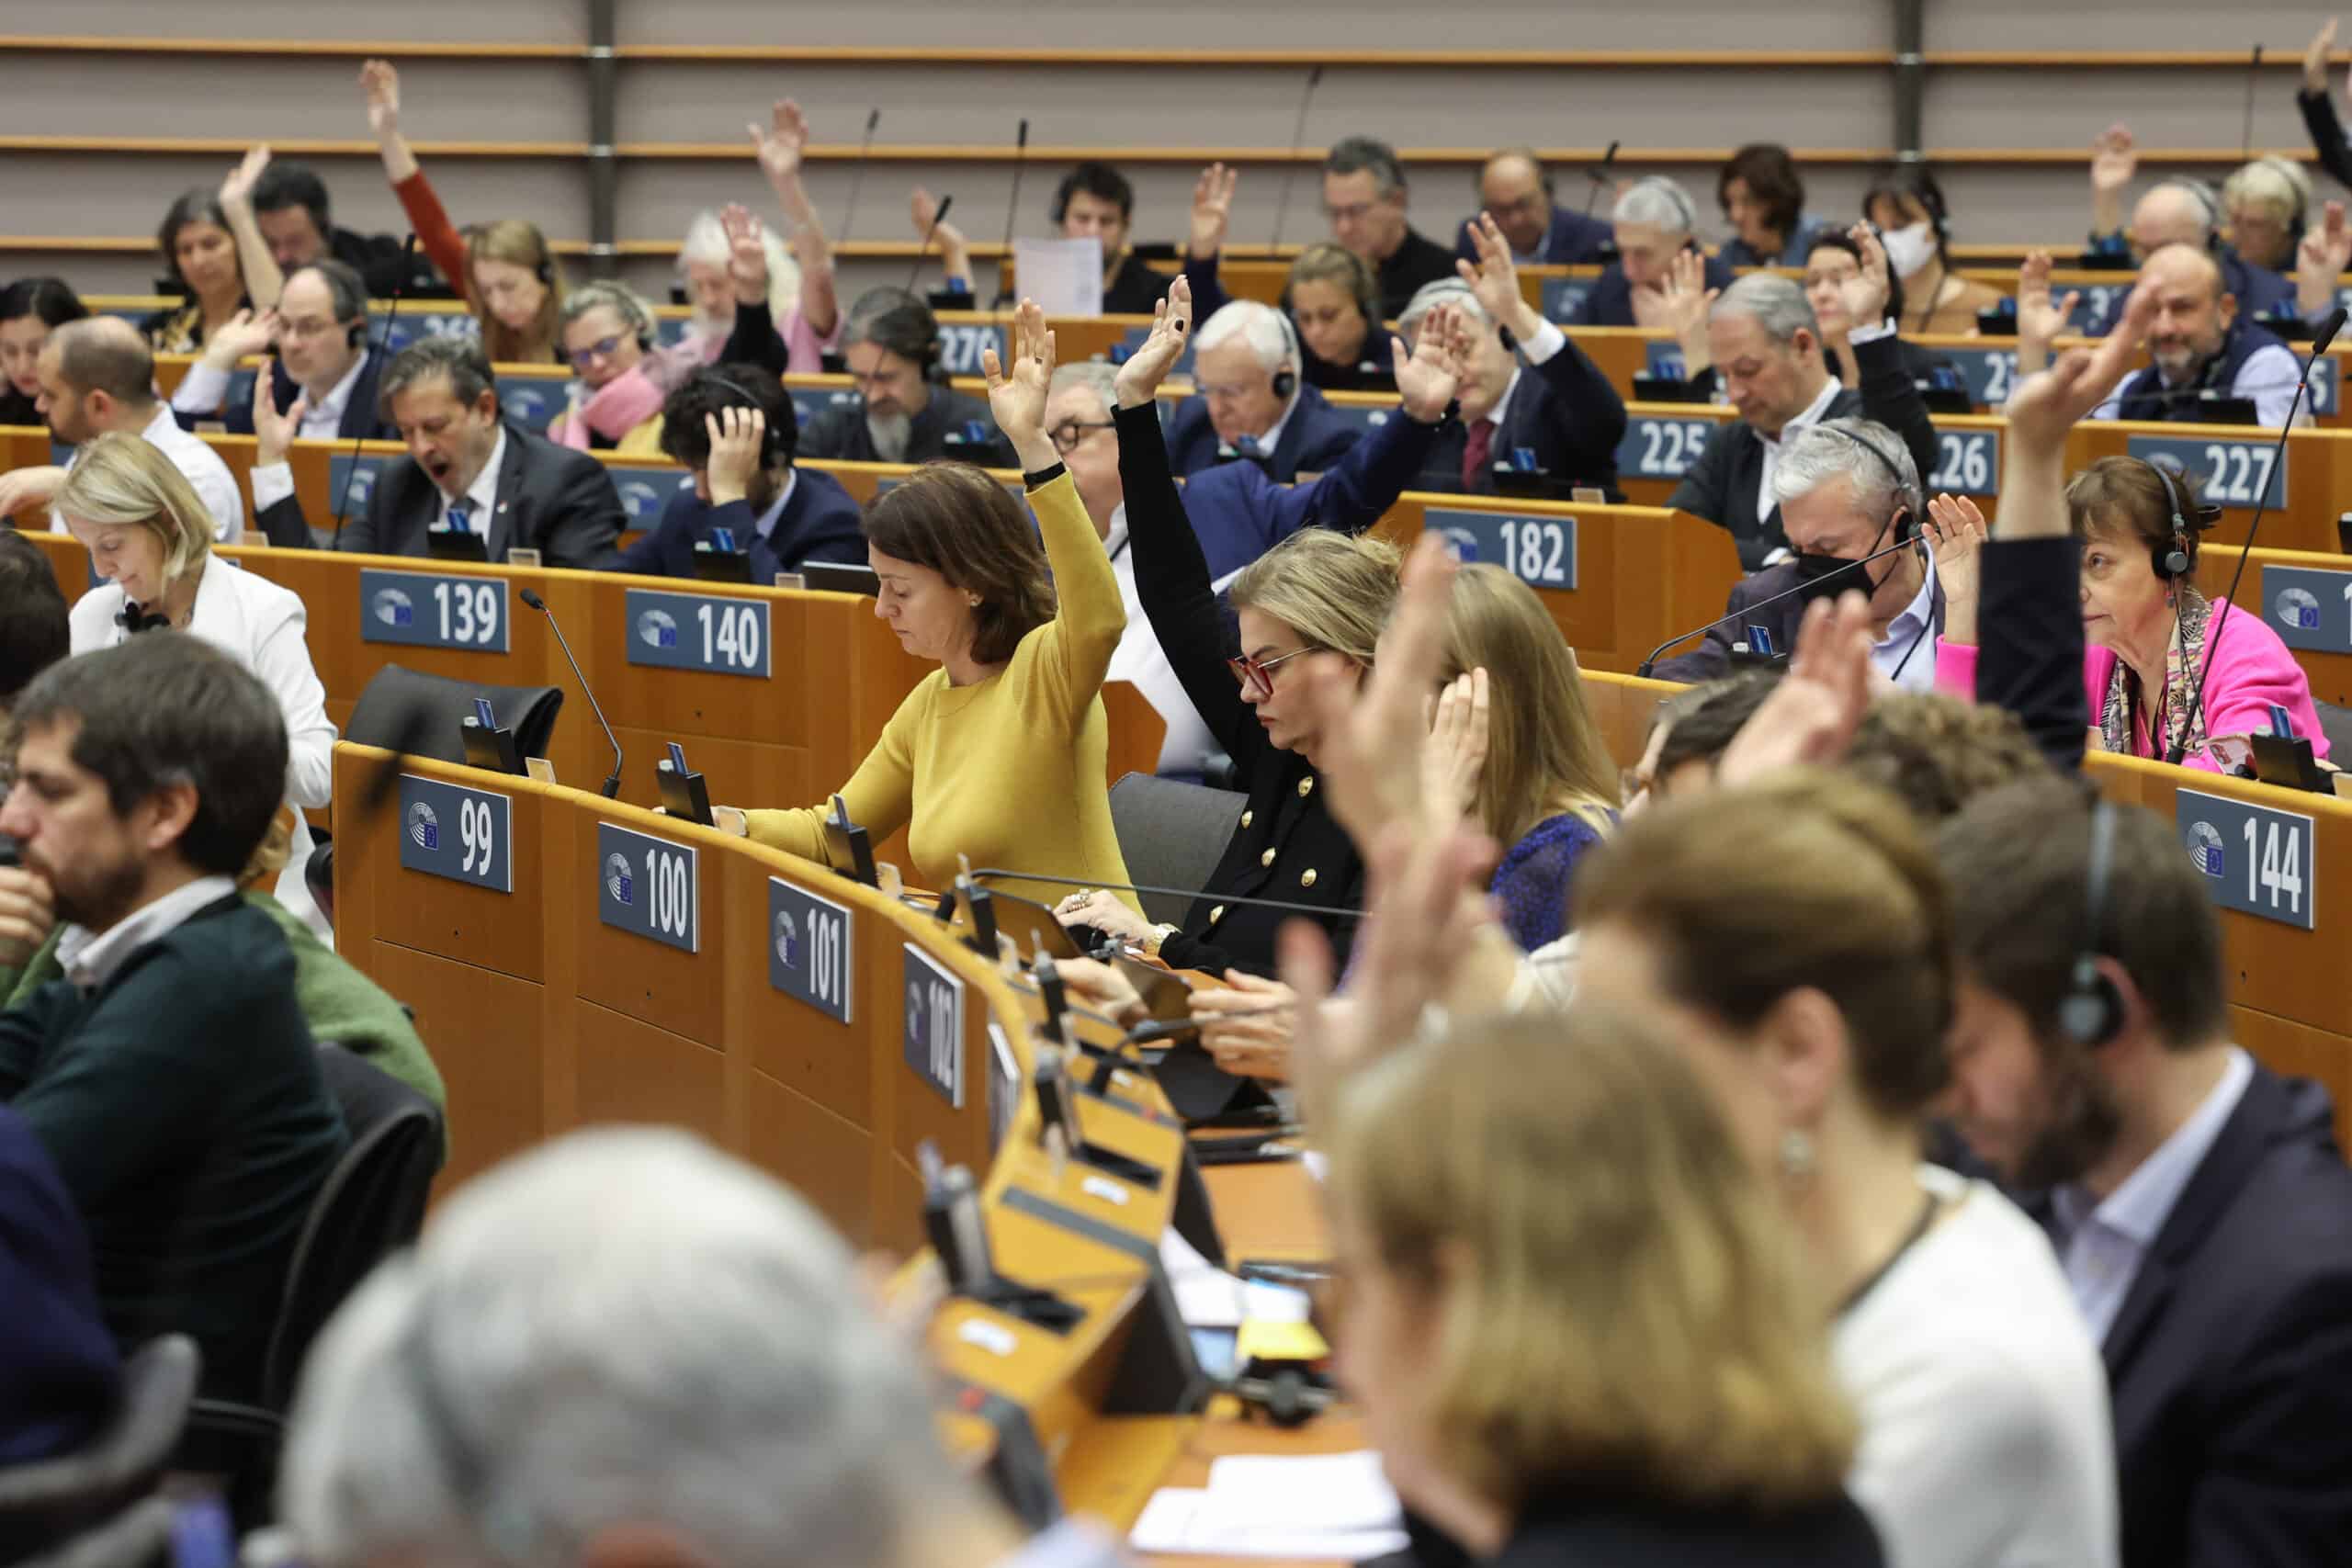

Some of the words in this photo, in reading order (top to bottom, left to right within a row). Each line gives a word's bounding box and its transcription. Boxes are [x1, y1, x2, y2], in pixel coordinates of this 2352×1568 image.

[1640, 421, 1706, 474] 225
[1928, 434, 1988, 491] 26
[2204, 445, 2278, 502] 227
[1499, 520, 1564, 581] 182
[434, 581, 498, 644] 139
[697, 604, 760, 669] 140
[460, 797, 492, 875] 99
[2244, 816, 2301, 914] 144
[646, 848, 687, 938] 100
[808, 907, 840, 1006] 101
[929, 979, 954, 1090] 102
